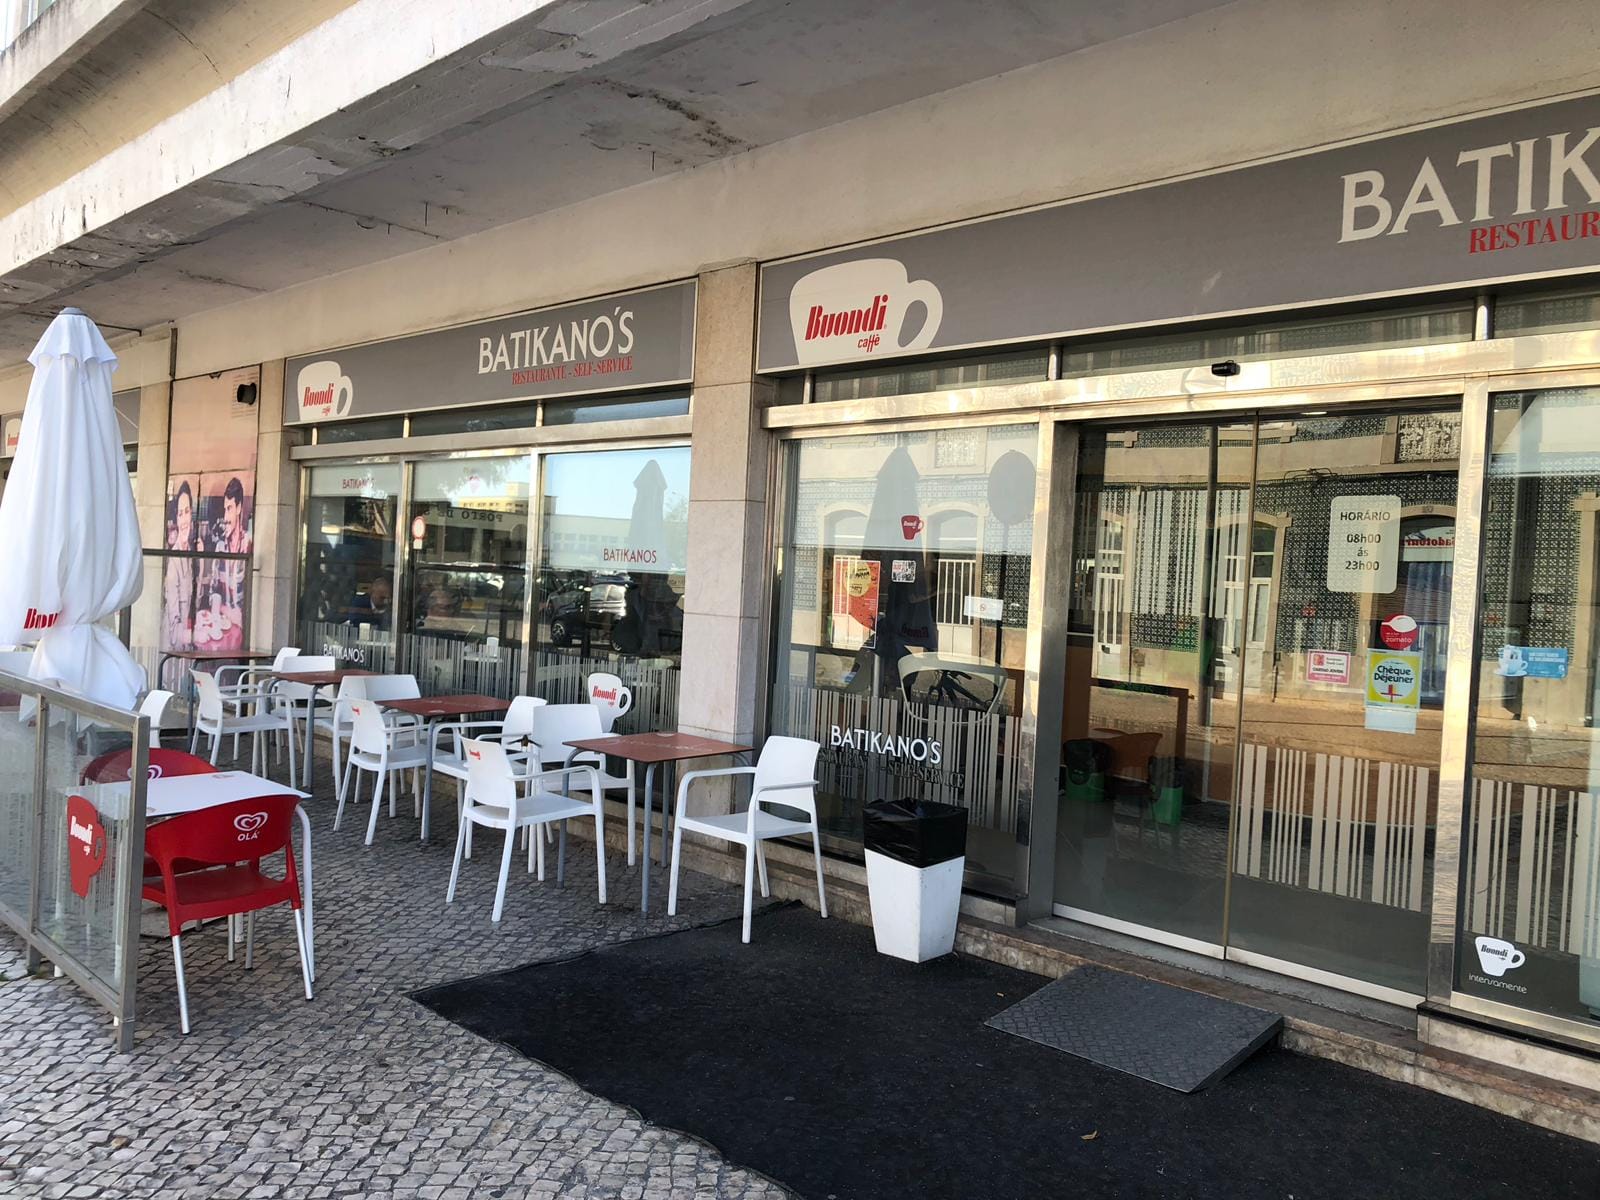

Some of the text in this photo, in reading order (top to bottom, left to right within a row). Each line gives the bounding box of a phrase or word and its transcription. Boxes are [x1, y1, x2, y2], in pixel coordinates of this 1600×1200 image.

[805, 293, 889, 341] Buondi
[511, 365, 567, 385] RESTAURANTE
[573, 355, 633, 378] SELF-SERVICE
[303, 382, 334, 407] Buondi
[1340, 509, 1391, 521] HORÁRIO
[1346, 533, 1381, 544] 08h00
[1345, 560, 1380, 571] 23h00
[1468, 973, 1528, 994] intensamente
